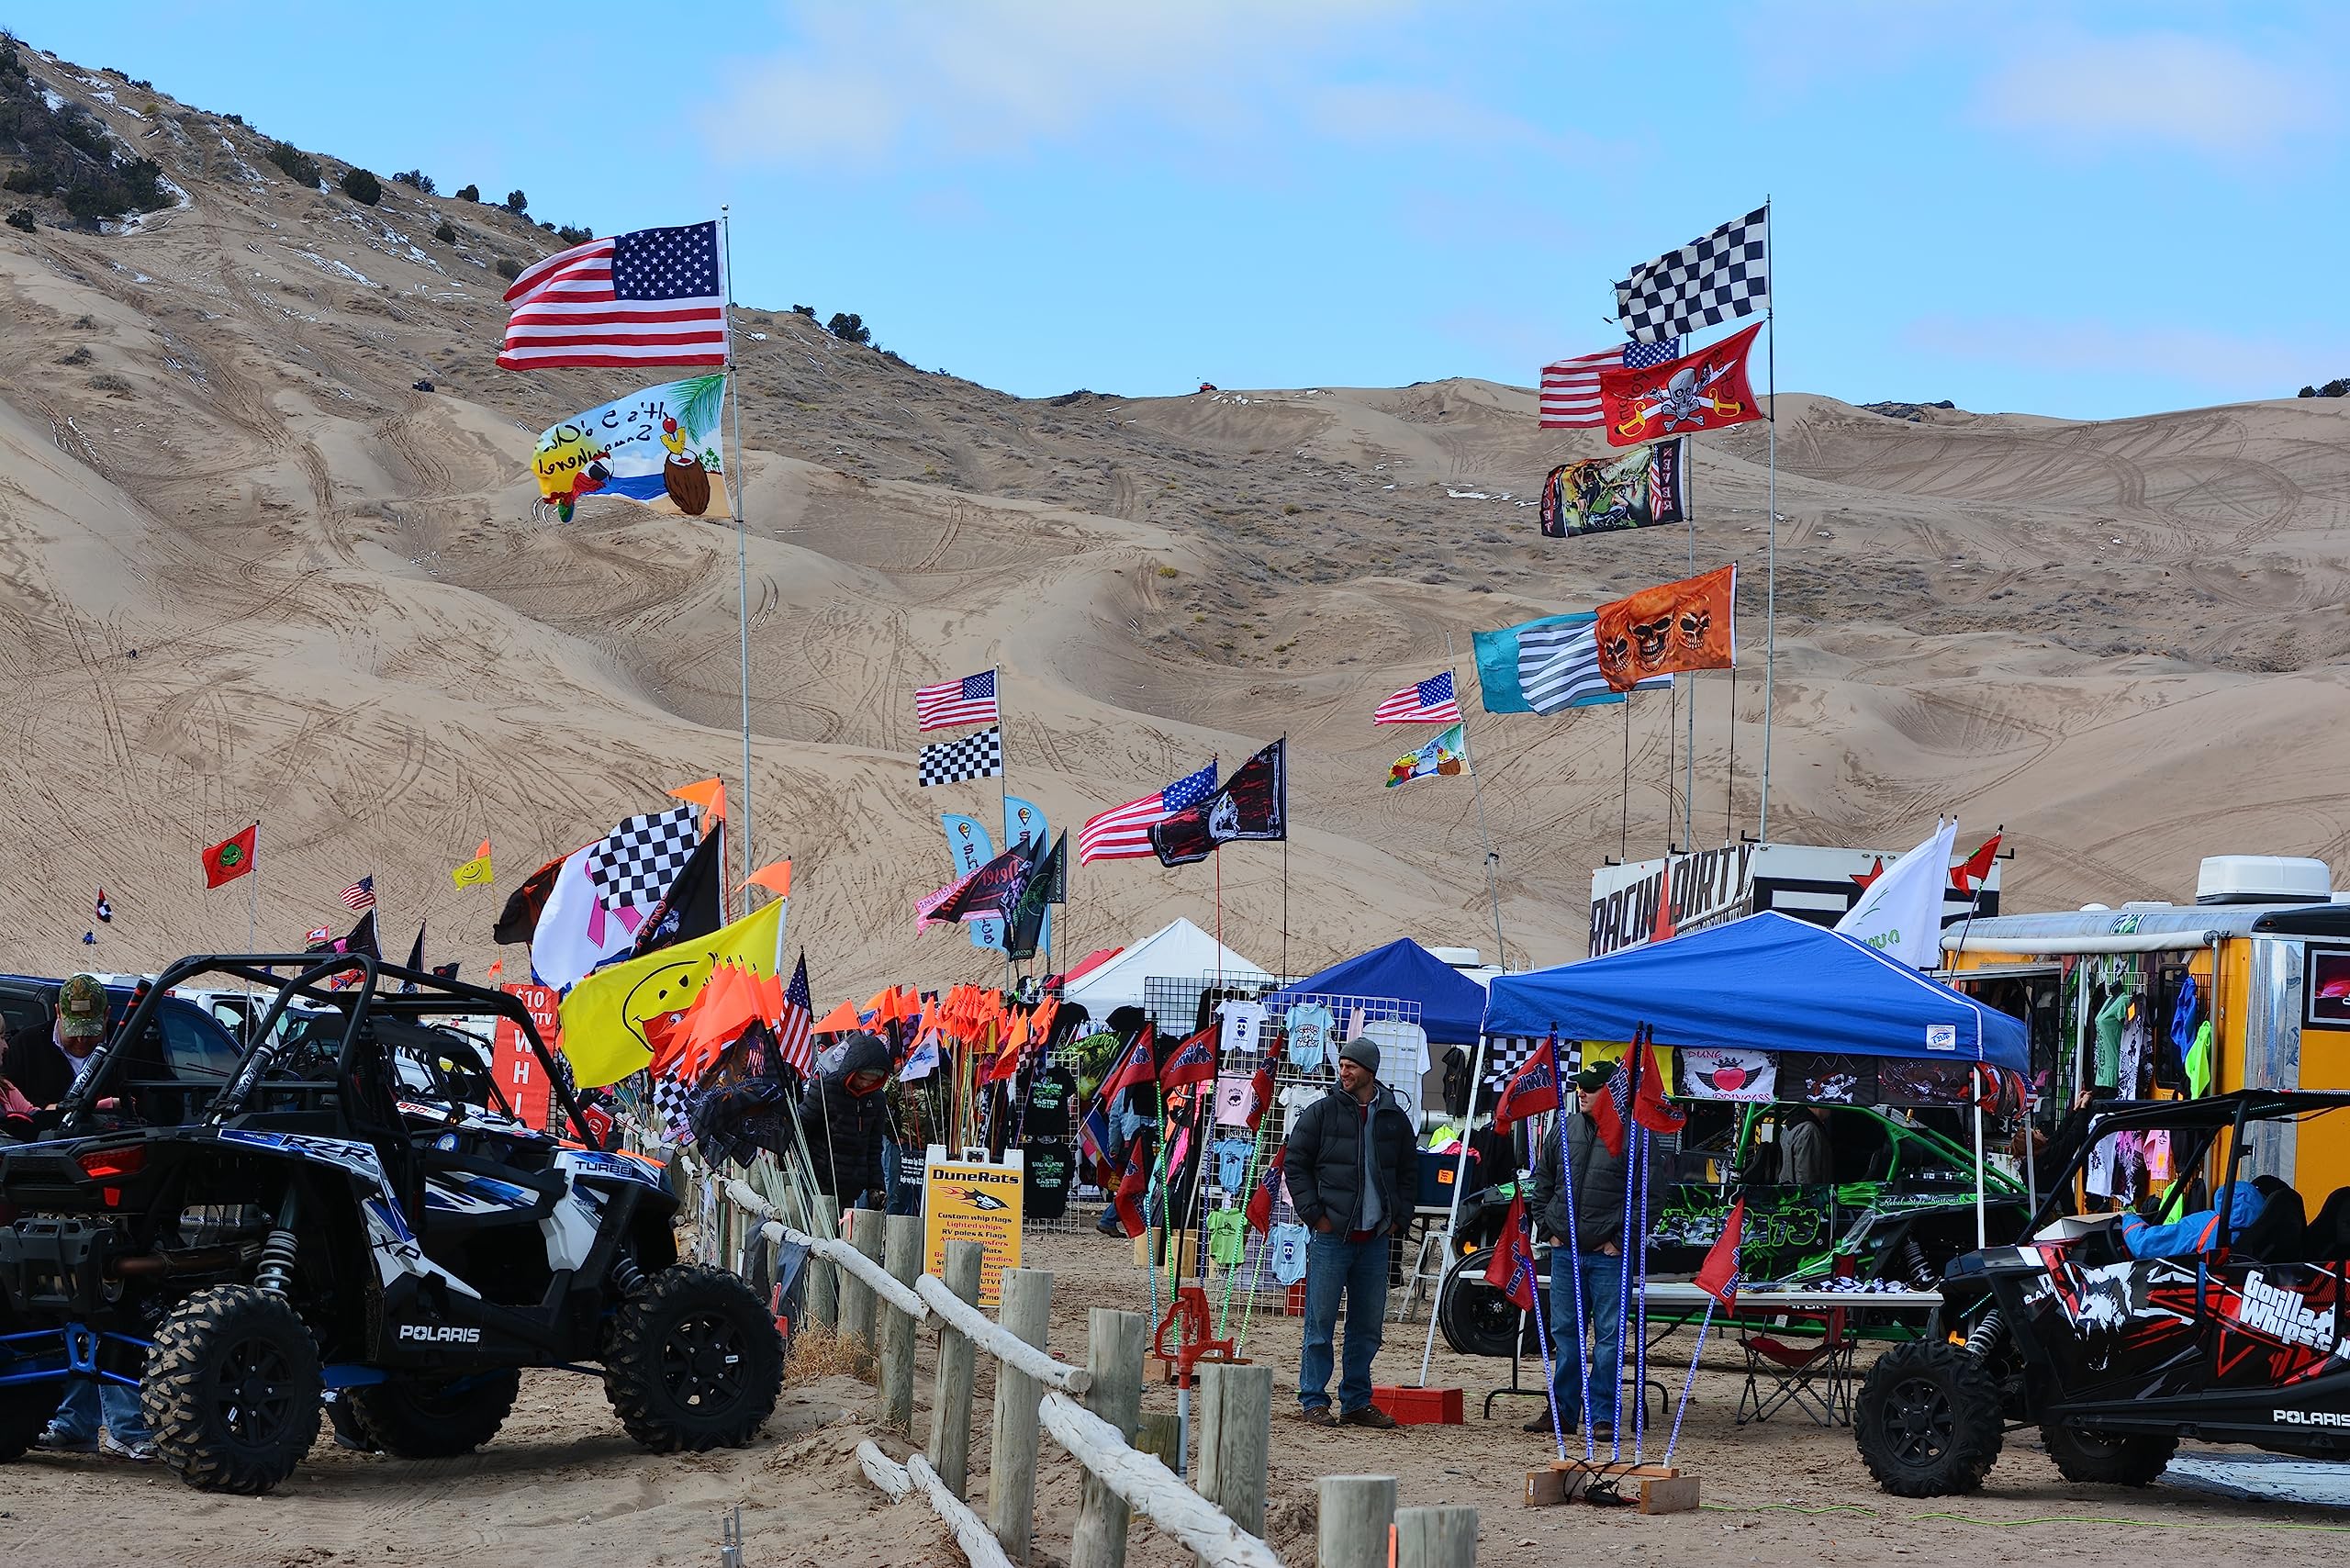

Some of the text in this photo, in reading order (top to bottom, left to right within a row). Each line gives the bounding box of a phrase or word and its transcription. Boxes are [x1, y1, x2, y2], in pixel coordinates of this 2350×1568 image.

[1668, 844, 1755, 925] DIRTY
[1688, 1049, 1722, 1059] DUNE
[282, 1135, 376, 1163] RZR
[575, 1160, 632, 1175] TURBO
[932, 1169, 1019, 1185] DuneRats
[937, 1212, 1013, 1225] Custom whip flags
[946, 1221, 1003, 1231] Lighted whips
[371, 1233, 421, 1260] XP
[2244, 1270, 2315, 1329] Gorilla
[399, 1325, 481, 1343] POLARIS
[2240, 1294, 2350, 1360] Whips.c
[2273, 1409, 2350, 1428] POLARIS
